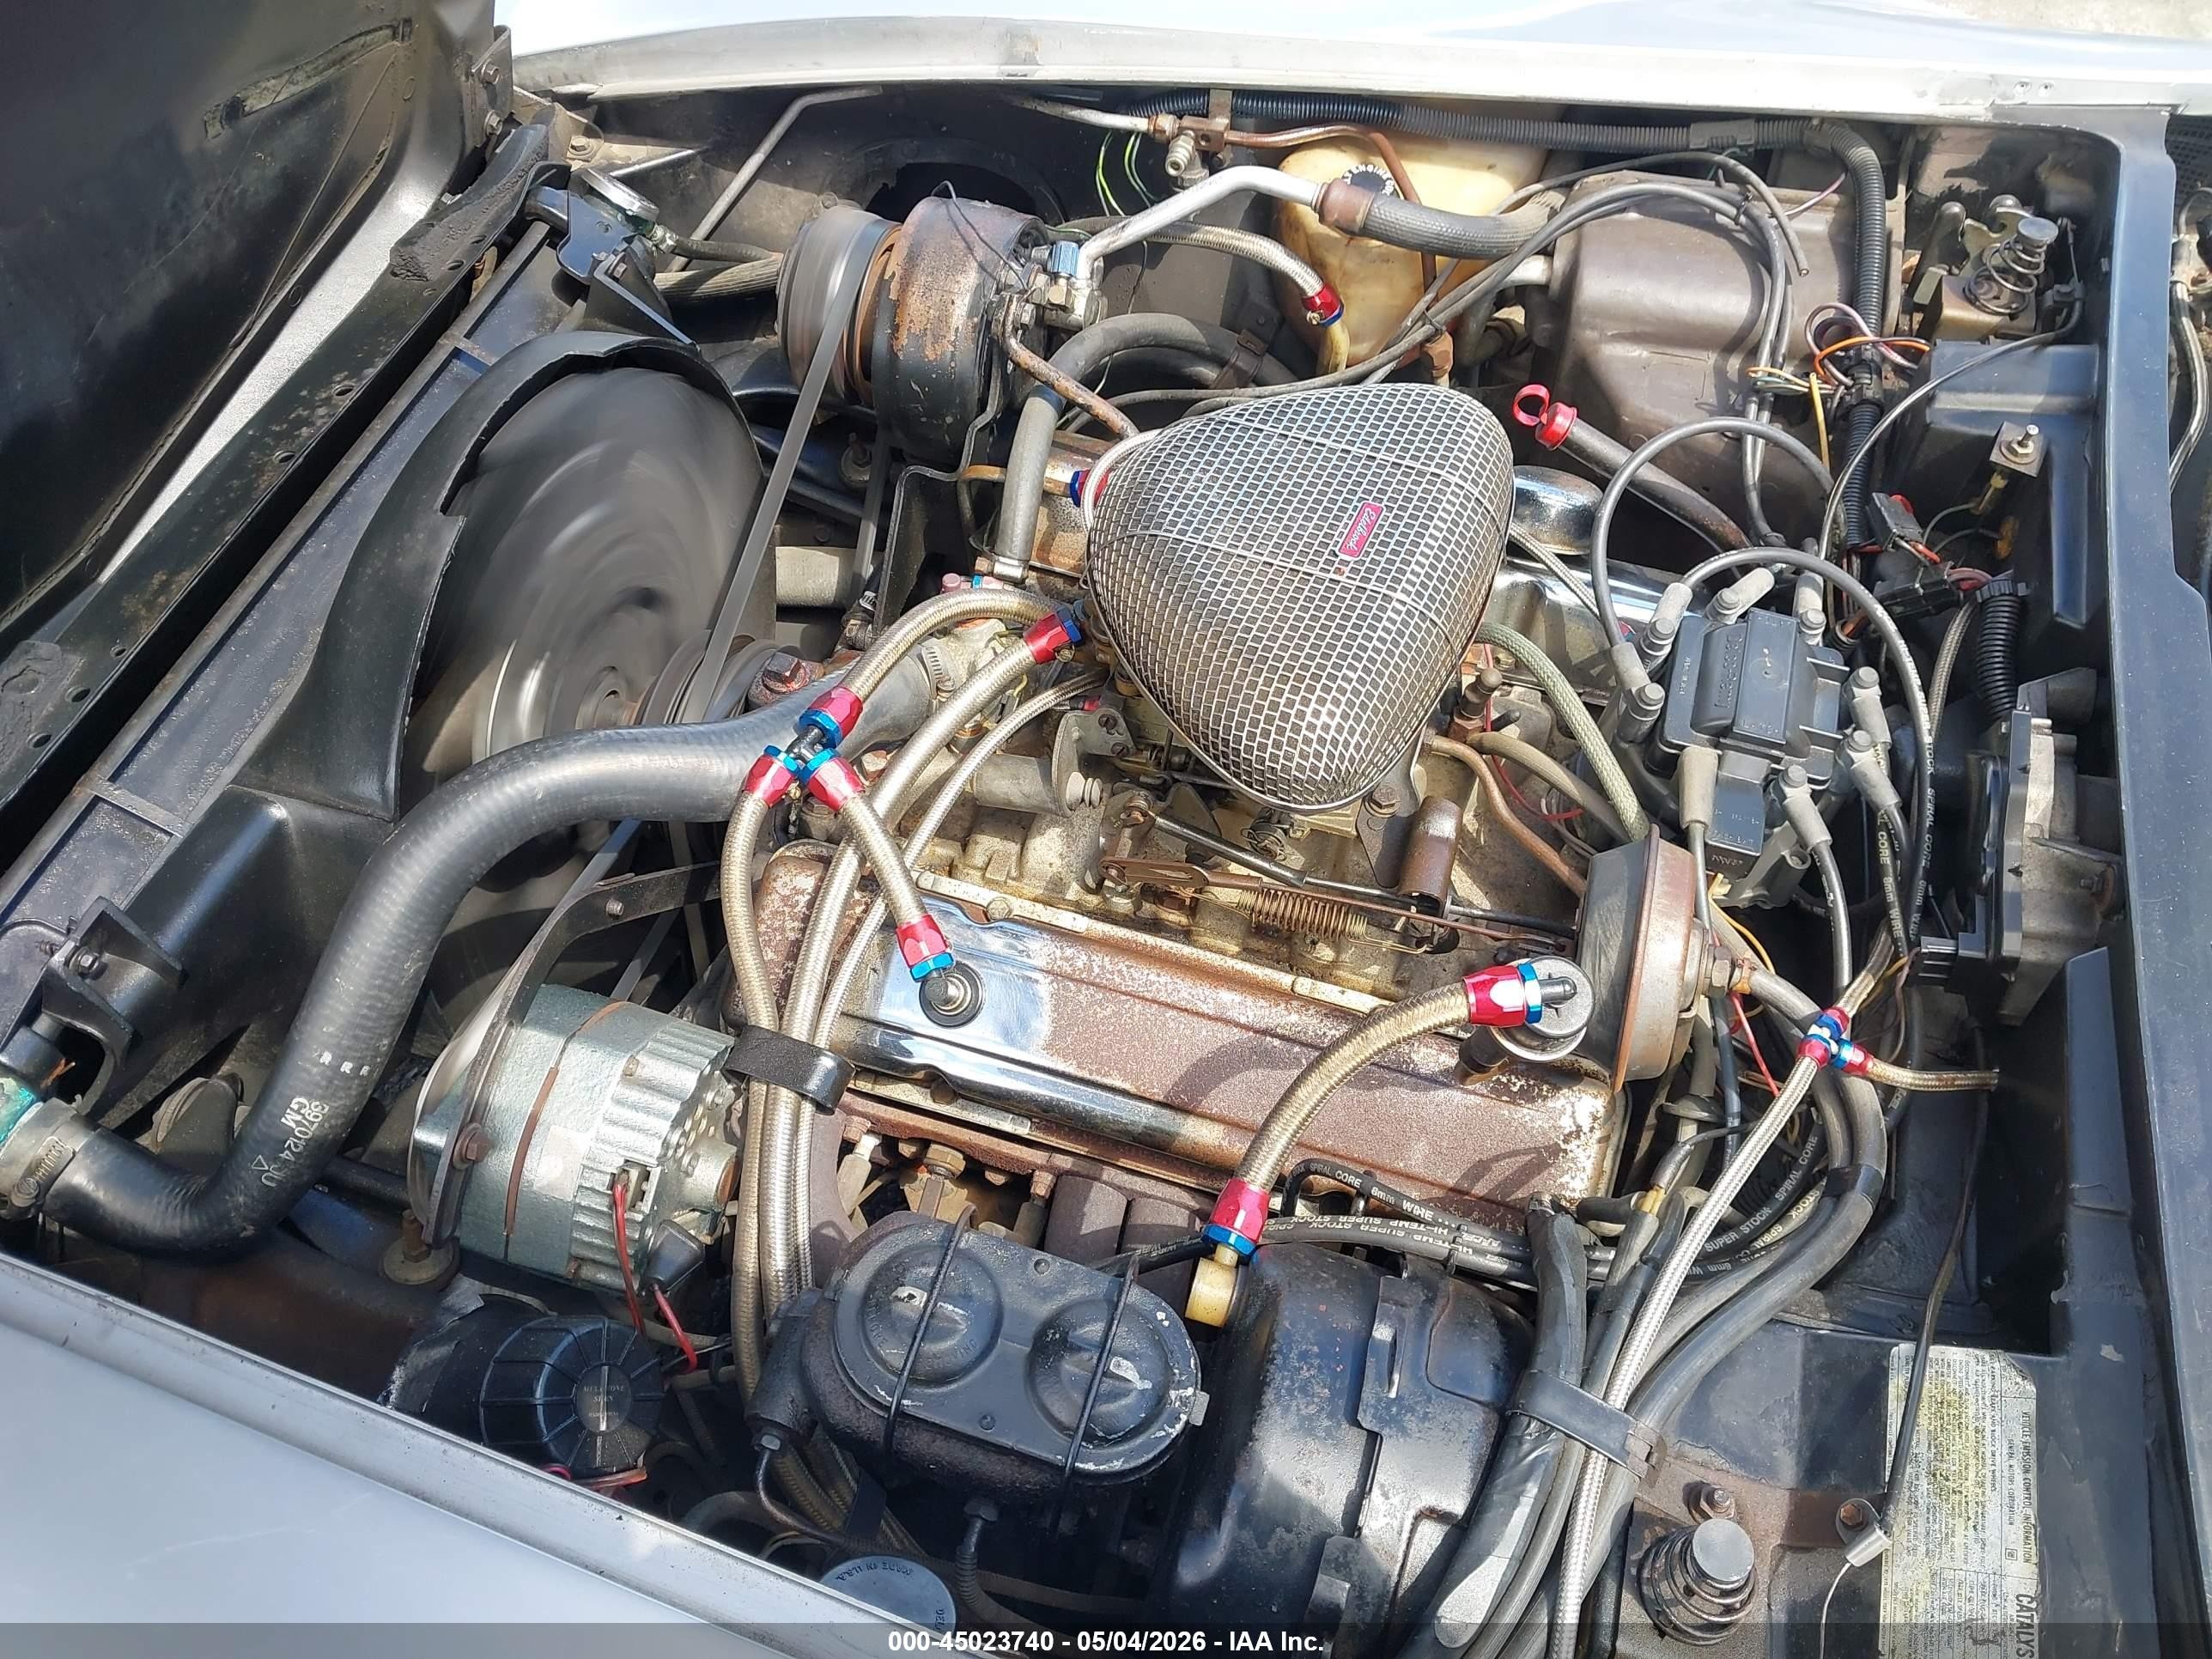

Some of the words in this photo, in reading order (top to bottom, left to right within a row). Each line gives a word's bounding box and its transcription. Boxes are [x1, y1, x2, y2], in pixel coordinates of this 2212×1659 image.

[1351, 164, 1391, 181] ENGINE
[1345, 507, 1376, 551] Edelbrock
[1917, 690, 1931, 730] SUPER
[1923, 736, 1936, 776] STOCK
[1926, 787, 1936, 829] SPIRAL
[1921, 832, 1933, 868] CORE
[1877, 830, 1891, 866] CORE
[1888, 908, 1904, 939] WIRE
[280, 1097, 312, 1131] GM
[279, 1100, 331, 1163] 3970124
[1309, 1162, 1332, 1177] SPIRAL
[1334, 1170, 1363, 1189] CORE
[1370, 1185, 1395, 1205] 8mm
[1402, 1199, 1435, 1222] WIRE
[1704, 1231, 1740, 1255] SUPER
[1740, 1205, 1772, 1236] STOCK
[1774, 1169, 1805, 1201] SPIRAL
[1798, 1135, 1820, 1167] CORE
[1789, 1188, 1821, 1220] STOCK
[1291, 1214, 1333, 1223] STOCK
[1308, 1220, 1354, 1230] STOCK
[1338, 1215, 1383, 1225] SUPER
[1359, 1223, 1407, 1237] SUPER
[1389, 1218, 1449, 1237] HI-TEMP
[1750, 1223, 1784, 1251] SPIRAL
[2021, 1411, 2032, 1438] VEHICLE
[2007, 1438, 2015, 1462] GENERAL
[2021, 1440, 2033, 1474] EMISSION
[2007, 1464, 2015, 1486] MOTORS
[2007, 1488, 2015, 1526] CORPORATION
[2021, 1477, 2033, 1509] CONTROL
[2021, 1514, 2033, 1564] INFORMATION
[866, 1560, 878, 1572] IN
[881, 1559, 915, 1577] MADE
